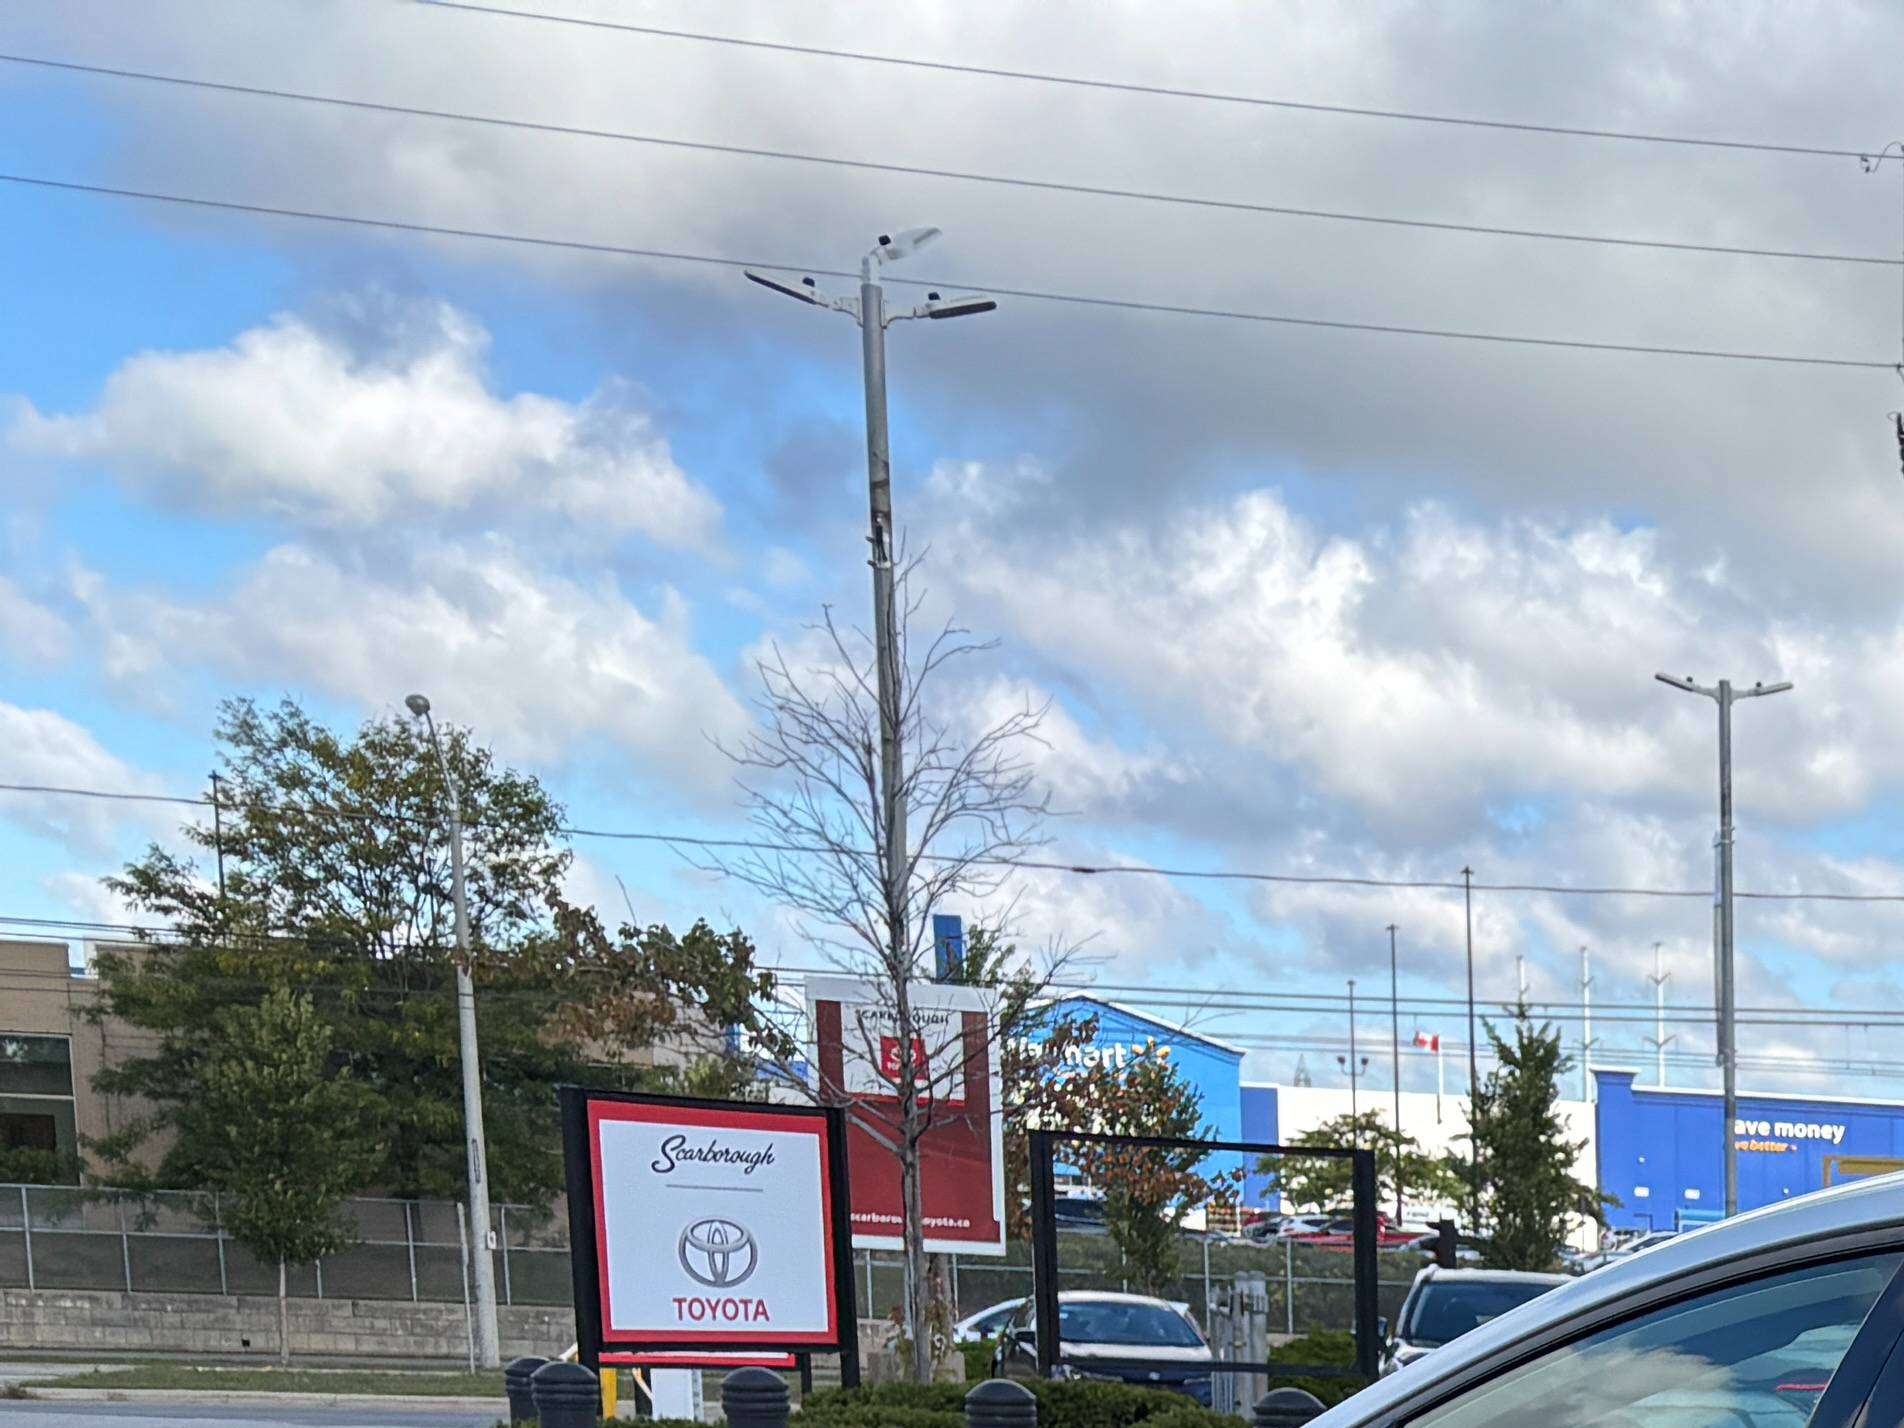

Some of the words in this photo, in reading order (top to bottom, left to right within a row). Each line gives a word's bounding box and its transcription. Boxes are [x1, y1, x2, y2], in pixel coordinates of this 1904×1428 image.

[1734, 1119, 1771, 1136] ave
[1774, 1122, 1846, 1145] money
[651, 1134, 775, 1175] Scarborough
[851, 1212, 971, 1228] scarborouoyota.ca
[672, 1296, 770, 1322] TOYOTA
